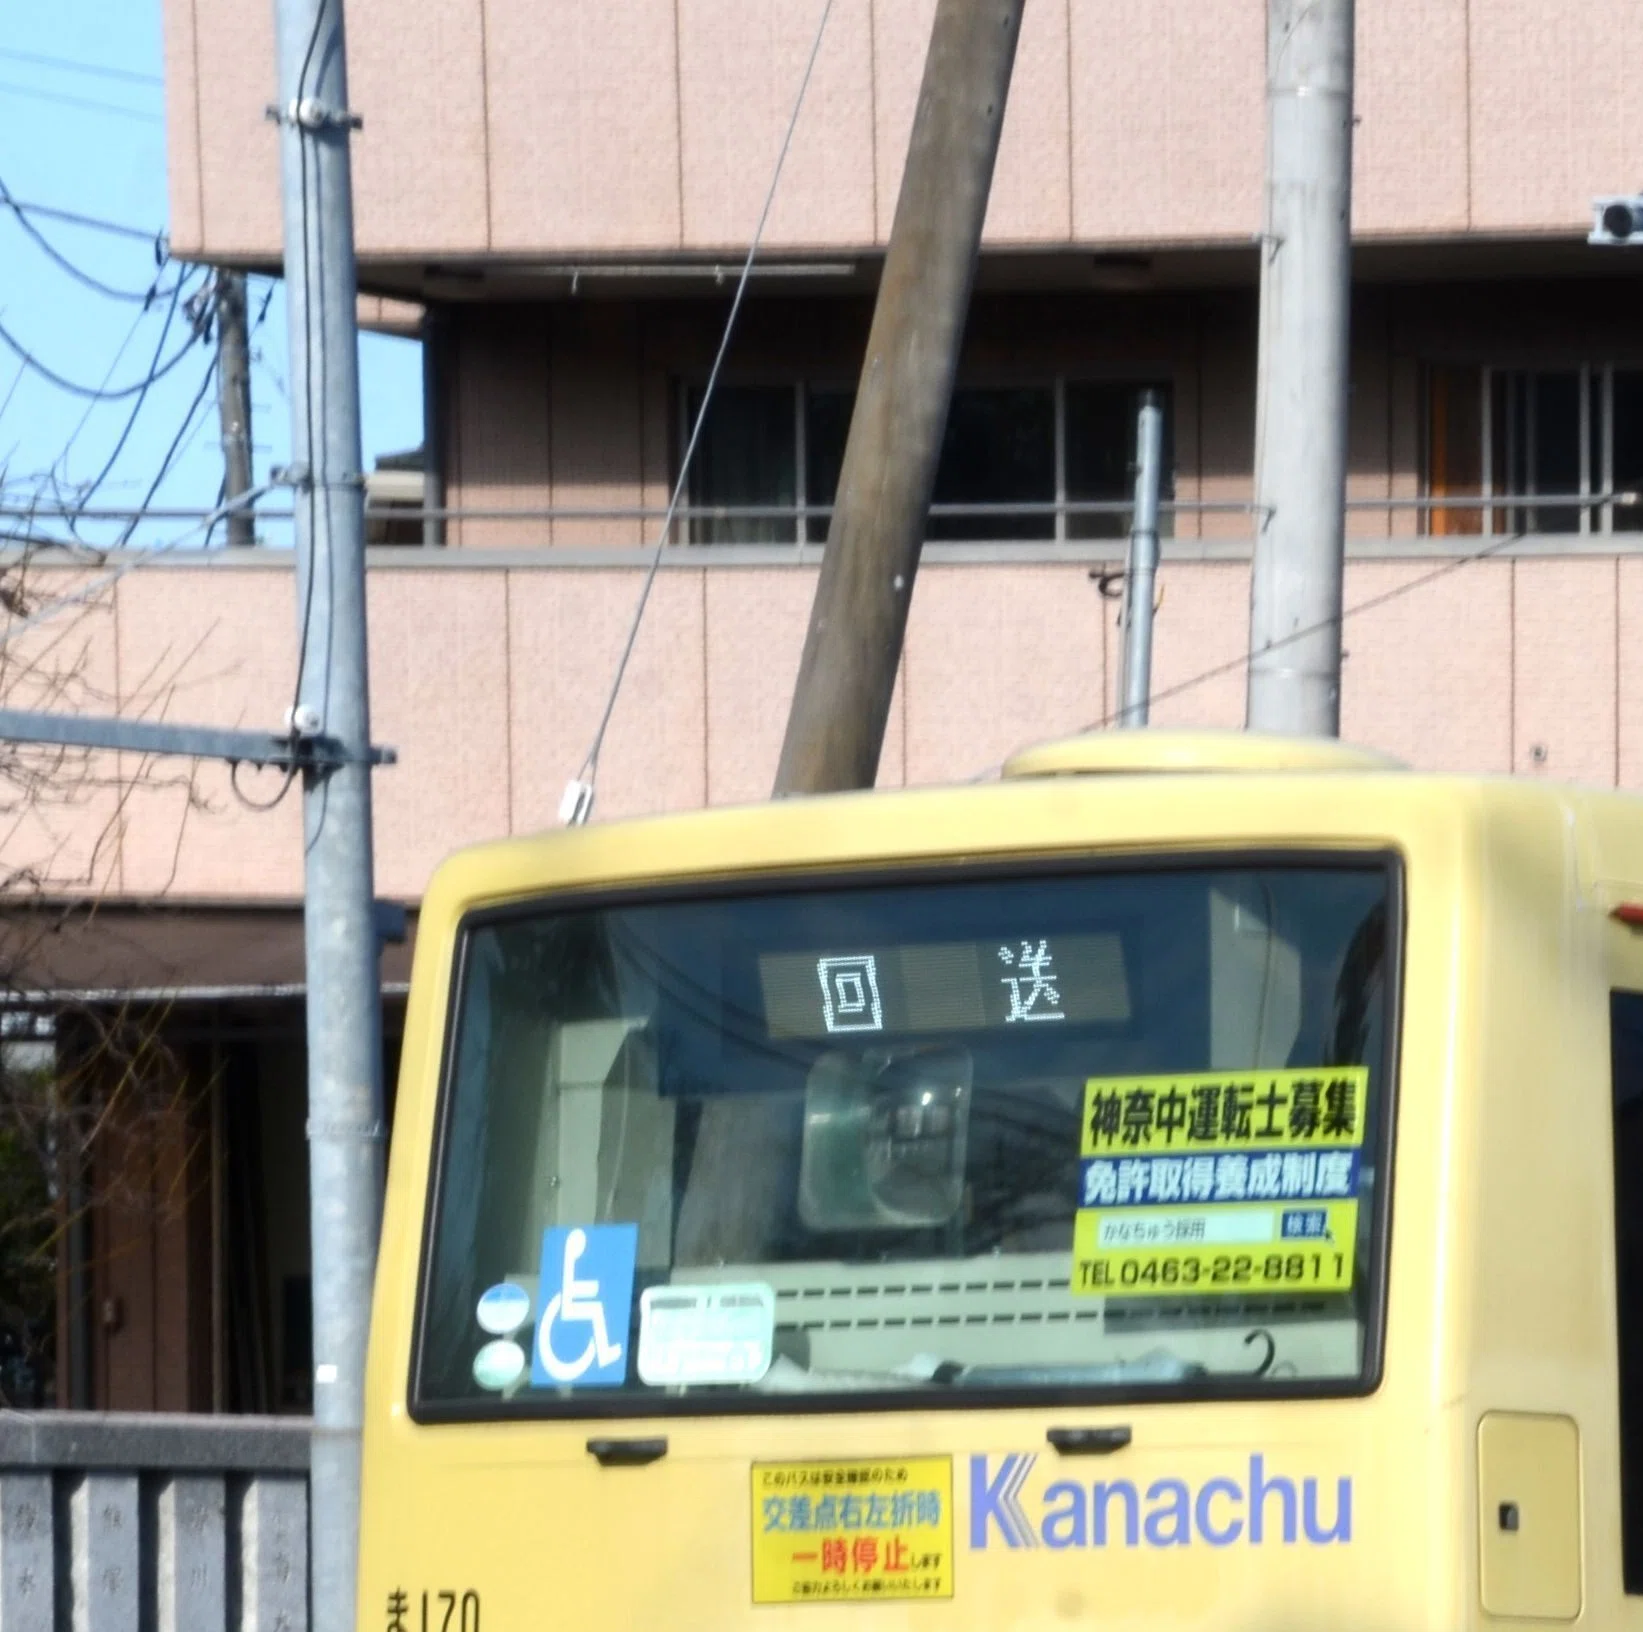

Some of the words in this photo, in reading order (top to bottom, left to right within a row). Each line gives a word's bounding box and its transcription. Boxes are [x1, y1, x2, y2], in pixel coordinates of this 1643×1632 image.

[1089, 1076, 1358, 1149] 神奈中運転士募集
[1083, 1150, 1352, 1206] 免許取得養成制度
[1102, 1216, 1207, 1243] かなちゅう採用
[1079, 1258, 1115, 1287] TEL
[1119, 1250, 1345, 1286] 0463-22-8811
[762, 1489, 941, 1534] 交差点右左折時
[968, 1451, 1354, 1550] Kanachu
